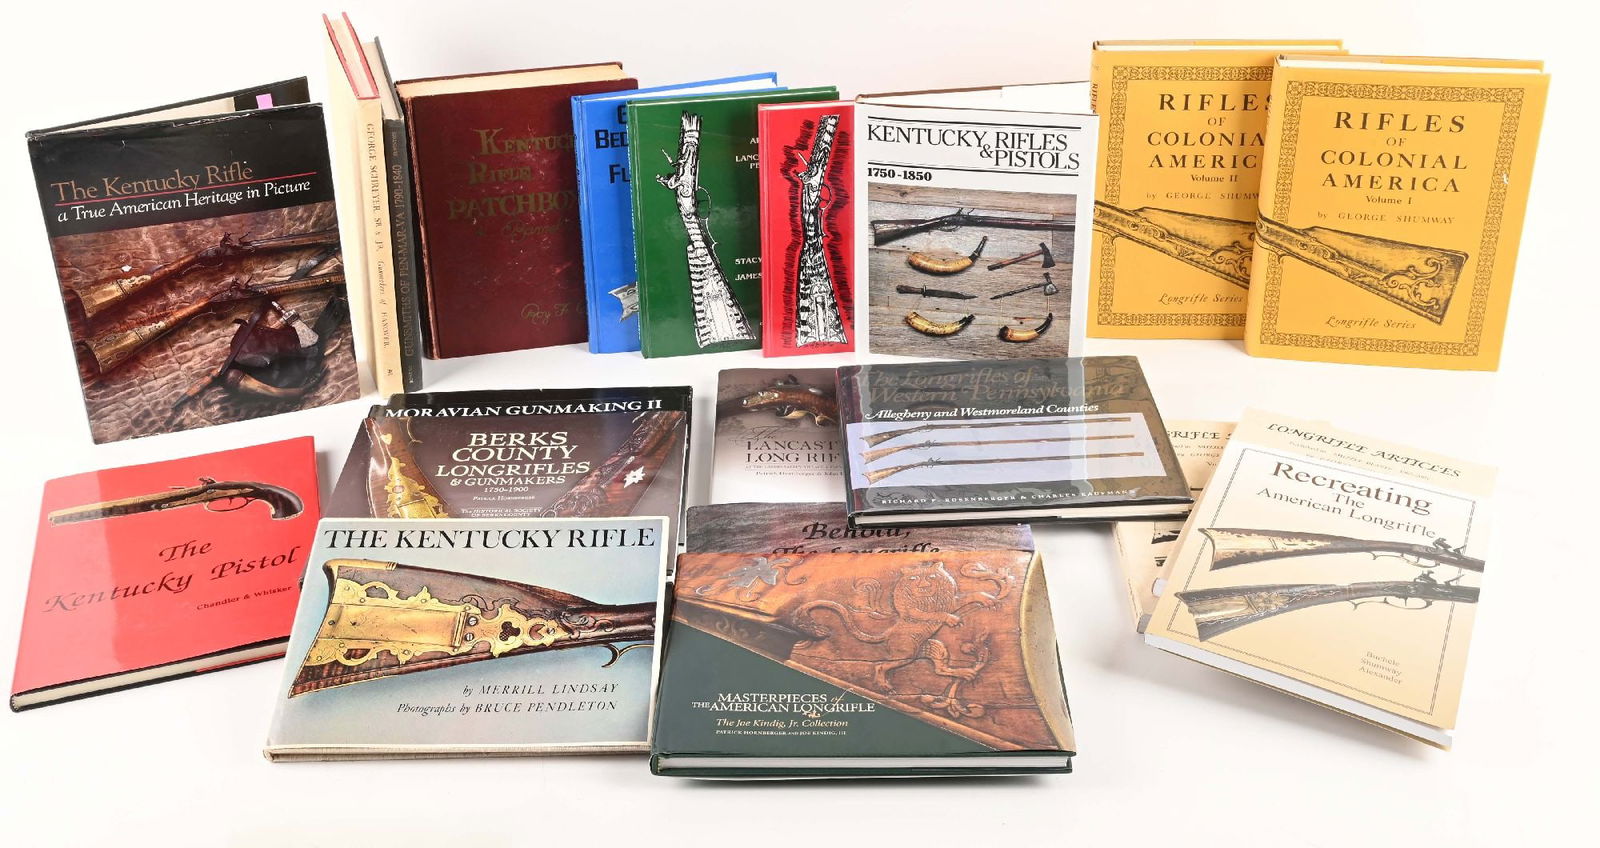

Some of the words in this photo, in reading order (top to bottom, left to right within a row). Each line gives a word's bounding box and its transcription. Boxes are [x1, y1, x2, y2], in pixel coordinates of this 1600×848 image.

[1207, 117, 1226, 126] OF
[1334, 111, 1465, 133] RIFLES
[367, 123, 377, 162] GEORGE
[867, 124, 987, 148] KENTUCKY
[995, 131, 1068, 152] RIFLES
[1147, 132, 1265, 147] COLONIA
[1386, 136, 1407, 147] OF
[980, 144, 994, 159] &
[994, 150, 1080, 170] PISTOLS
[1148, 154, 1257, 169] AMERIC
[1320, 150, 1468, 170] COLONIAL
[50, 179, 98, 202] The
[102, 168, 200, 198] Kentucky
[205, 161, 254, 185] Rifle
[392, 164, 405, 208] 1790-1840
[1191, 174, 1225, 183] Volume
[1229, 174, 1239, 183] II
[1322, 172, 1460, 192] AMERICA
[57, 212, 69, 223] a
[71, 205, 107, 222] True
[109, 198, 182, 218] American
[184, 188, 243, 208] Heritage
[246, 186, 261, 200] in
[264, 180, 311, 198] Picture
[1146, 192, 1156, 200] by
[1166, 192, 1212, 200] GEORGE
[1366, 195, 1402, 204] Volume
[1408, 196, 1412, 205] I
[1317, 211, 1328, 220] by
[1338, 212, 1387, 222] GEORGE
[1396, 215, 1455, 224] SHUMWAY
[400, 280, 410, 294] OF
[1159, 292, 1208, 306] Longrifle
[1212, 293, 1243, 304] Series
[1324, 316, 1380, 330] Longrifle
[1383, 319, 1416, 330] Series
[385, 406, 502, 418] MORAVIAN
[504, 400, 642, 416] GUNMAKING
[646, 400, 663, 410] II
[864, 408, 932, 420] Allegheny
[934, 408, 958, 418] and
[960, 404, 1044, 417] Westmoreland
[1046, 403, 1099, 414] Counties
[467, 432, 568, 447] BERKS
[746, 440, 839, 450] LANCAST
[451, 445, 579, 462] COUNTY
[746, 452, 800, 462] LONG
[1266, 423, 1368, 454] LONGRIFLE
[1370, 449, 1462, 478] ARTICLES
[434, 462, 591, 478] LONGRIFLES
[450, 478, 461, 486] &
[464, 475, 566, 486] GUNMAKERS
[1271, 461, 1434, 516] Recreating
[1334, 492, 1366, 509] The
[1256, 487, 1342, 515] American
[1350, 508, 1437, 538] Longrifle
[324, 528, 388, 550] THE
[394, 528, 561, 550] KENTUCKY
[567, 528, 656, 548] RIFLE
[158, 540, 212, 562] The
[43, 572, 193, 613] Kentucky
[210, 545, 302, 581] Pistol
[196, 596, 240, 610] Chandler
[254, 585, 292, 598] Whisker
[1359, 666, 1402, 684] Alexander
[1360, 658, 1402, 677] Shumway
[462, 684, 474, 698] by
[479, 684, 545, 695] MERRILL
[552, 683, 619, 695] LINDSAY
[718, 694, 828, 703] MASTERPIECES
[396, 702, 456, 717] Photographs
[459, 703, 470, 716] by
[475, 702, 522, 713] BRUCE
[528, 700, 618, 713] PENDLETON
[709, 702, 790, 712] AMERICAN
[793, 702, 876, 713] LONGRIFLE
[716, 718, 734, 727] The
[736, 719, 750, 728] Joe
[752, 719, 786, 729] Kindig,
[788, 719, 800, 728] Jr.
[802, 718, 848, 728] Collection
